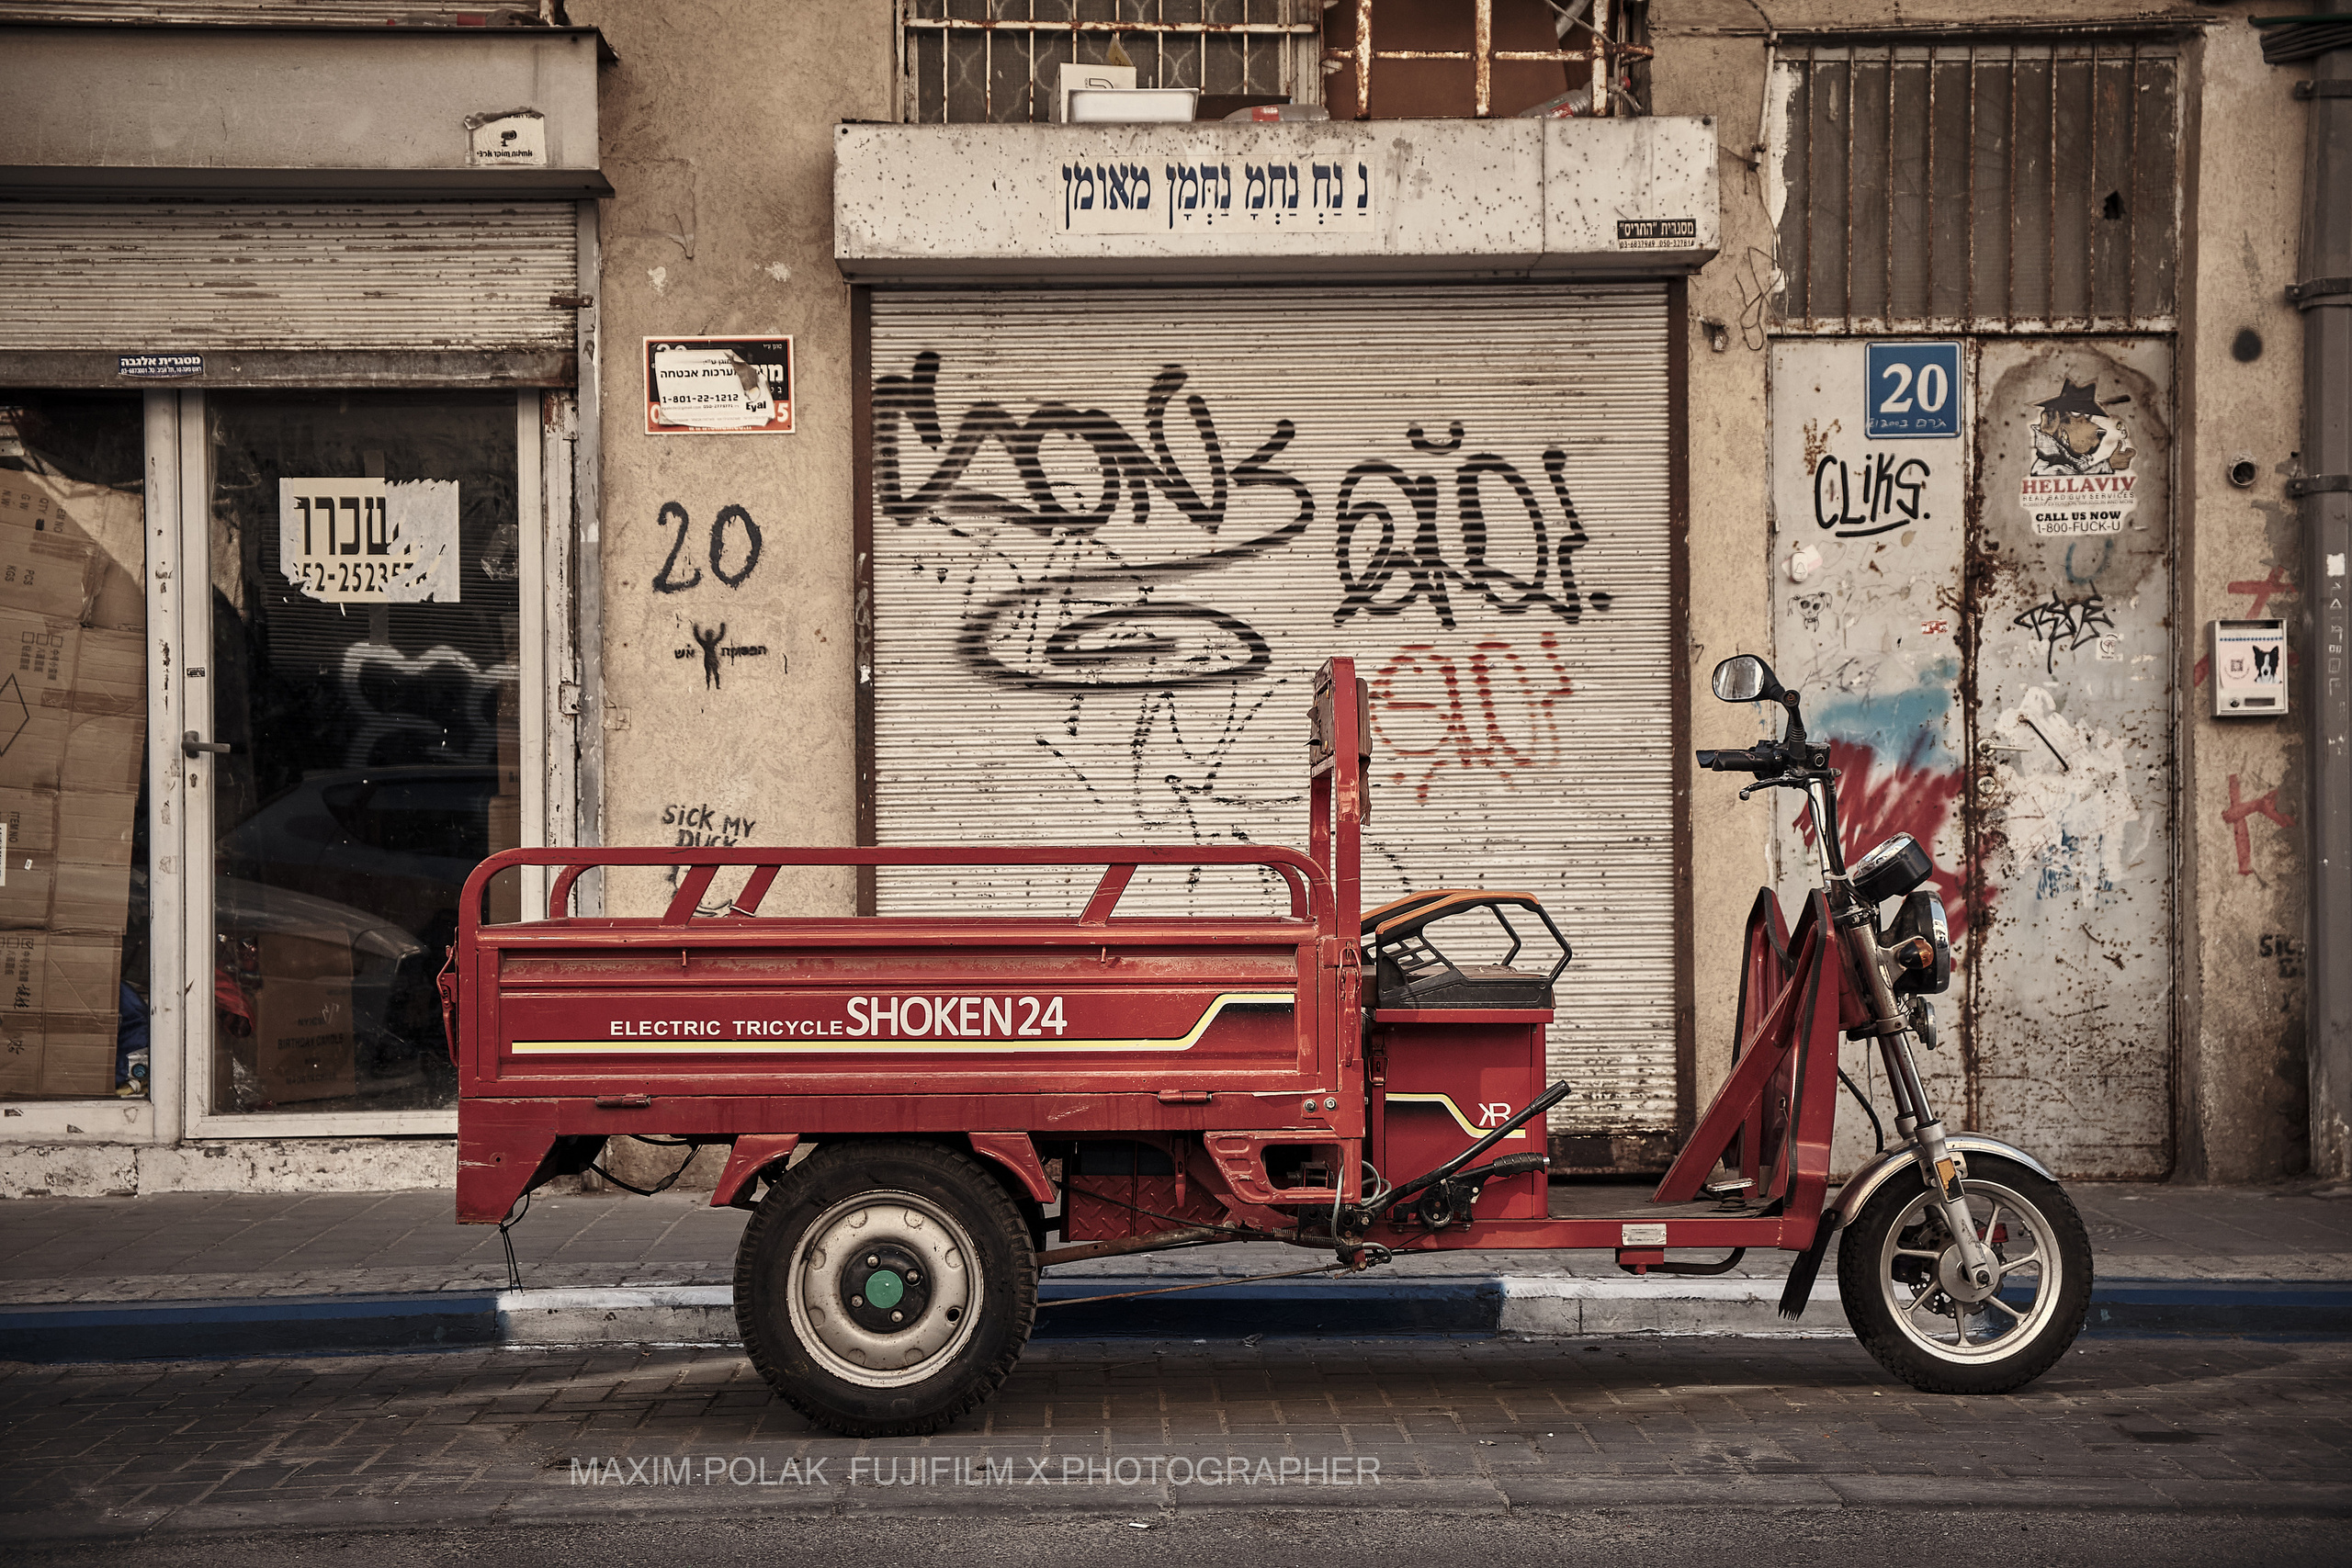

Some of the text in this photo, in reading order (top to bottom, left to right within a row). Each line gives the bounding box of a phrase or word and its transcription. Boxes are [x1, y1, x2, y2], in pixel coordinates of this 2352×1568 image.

[1062, 161, 1149, 230] מאומן
[1661, 221, 1694, 235] מסגרית
[120, 355, 201, 367] מסגרית אלגבה
[660, 368, 738, 378] ערכות אבטחה
[1880, 363, 1948, 412] 20
[662, 393, 739, 403] 1-801-22-1212
[746, 400, 766, 412] Eyal
[2022, 476, 2136, 494] HELLAVIV
[2089, 491, 2135, 500] SERVICES
[2035, 511, 2121, 522] CALL US NOW
[2037, 521, 2120, 533] 1-800-FUCK-U
[651, 501, 763, 593] 20
[722, 815, 756, 838] MY
[610, 1020, 721, 1036] ELECTRIC
[732, 1020, 843, 1036] TRICYCLE
[277, 1033, 344, 1051] BIRTHDAY CANDLE
